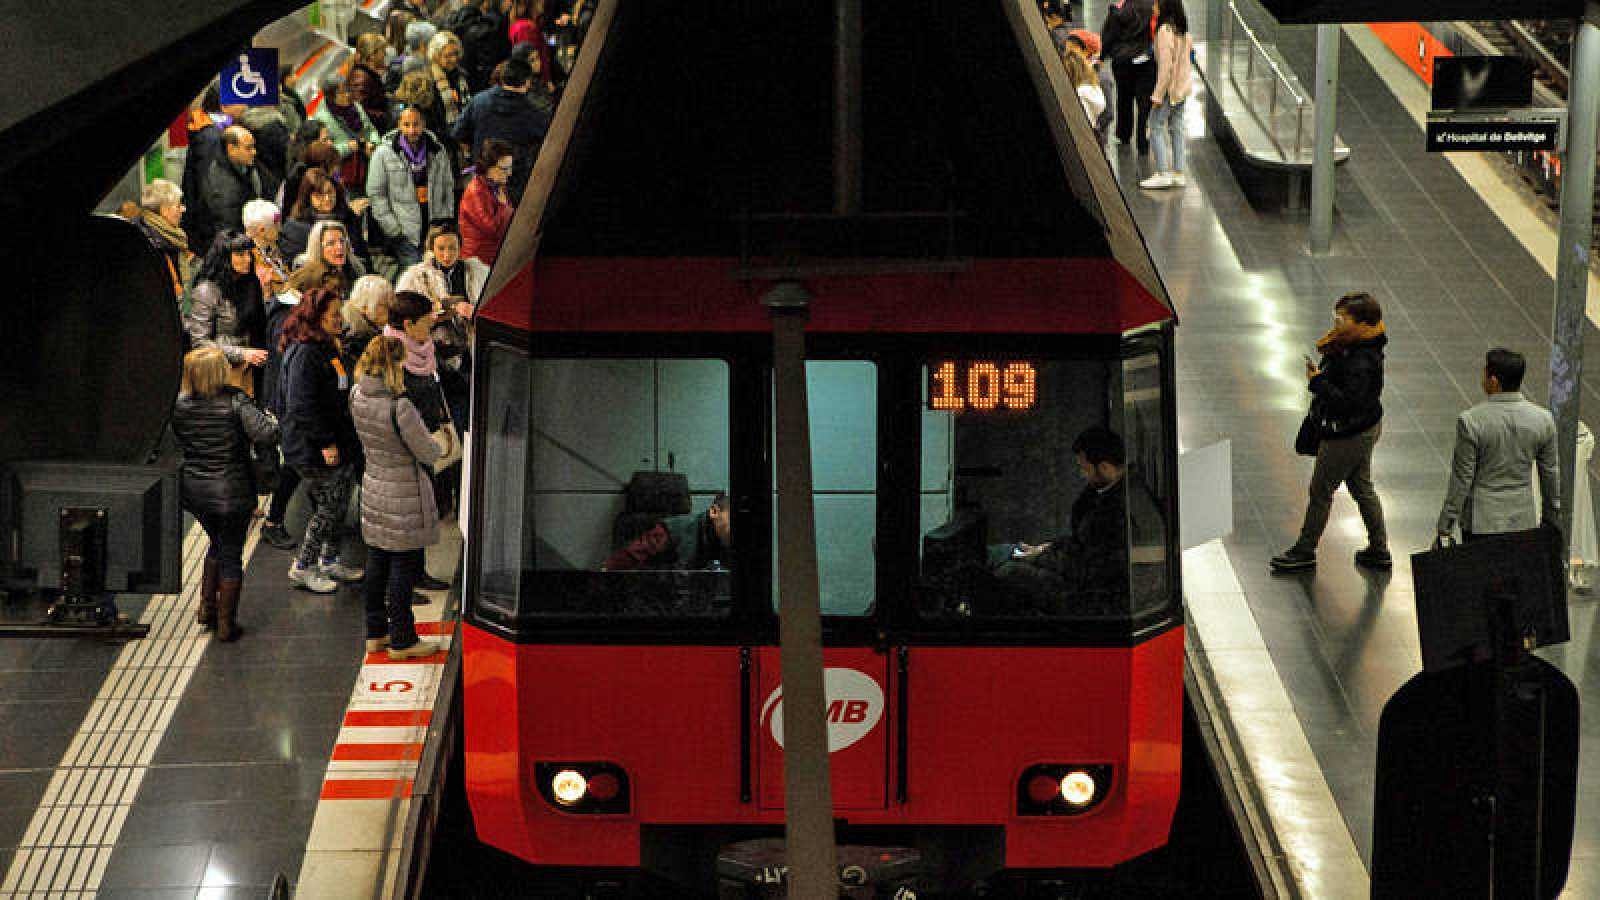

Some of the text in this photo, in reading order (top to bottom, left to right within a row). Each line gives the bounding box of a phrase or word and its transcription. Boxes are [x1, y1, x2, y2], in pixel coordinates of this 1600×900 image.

[1447, 132, 1487, 144] Hospital
[1489, 131, 1503, 142] de
[932, 362, 1036, 409] 109
[825, 699, 870, 723] MB
